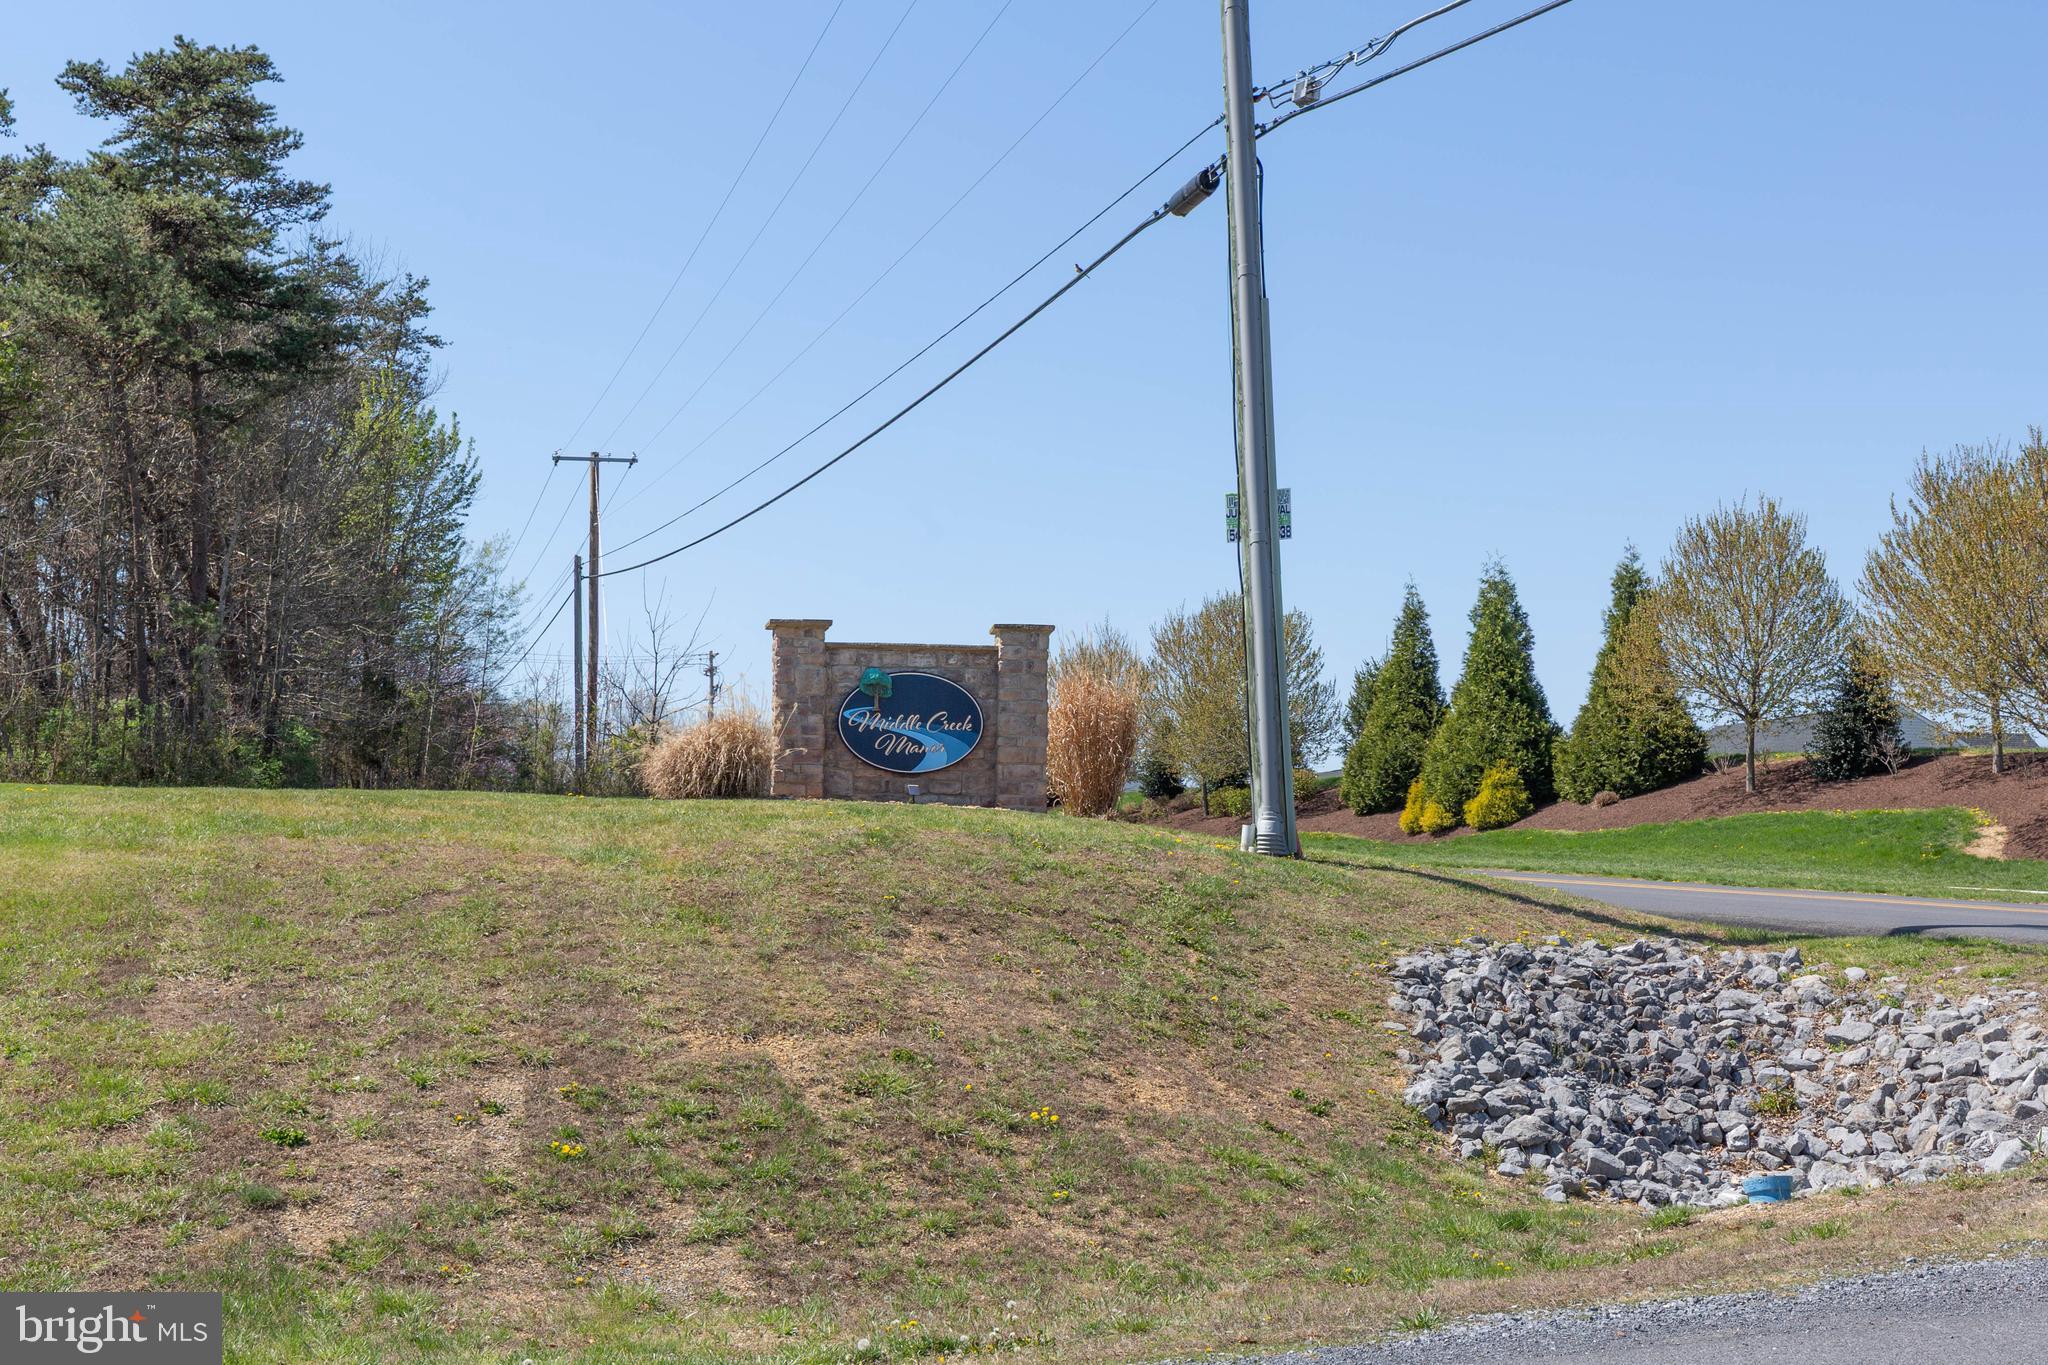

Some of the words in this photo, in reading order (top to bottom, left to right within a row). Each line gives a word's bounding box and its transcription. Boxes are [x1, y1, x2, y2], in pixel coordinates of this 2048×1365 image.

[848, 708, 922, 733] Middle
[926, 711, 973, 734] Creek
[874, 733, 946, 756] Manor
